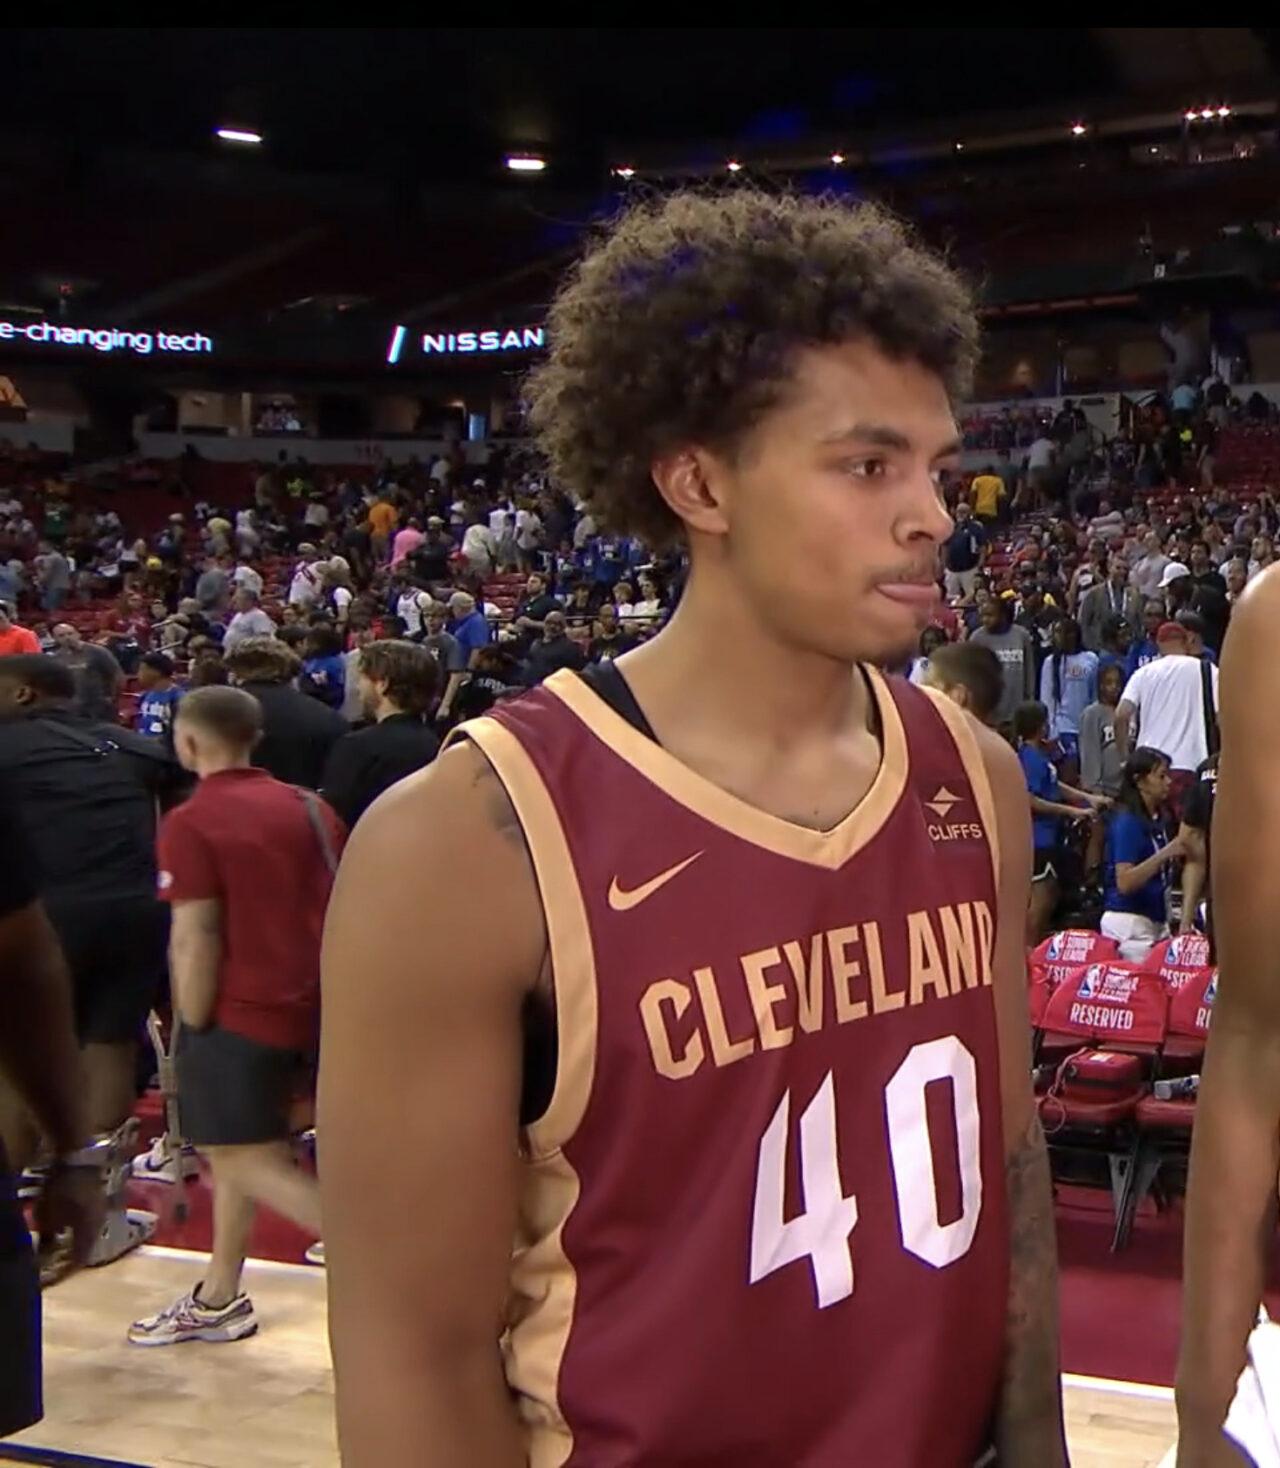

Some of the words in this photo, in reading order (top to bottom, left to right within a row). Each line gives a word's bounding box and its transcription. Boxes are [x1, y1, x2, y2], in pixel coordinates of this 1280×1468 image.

[157, 332, 212, 352] tech
[423, 328, 544, 352] NISSAN
[928, 823, 983, 841] CLIFFS
[638, 900, 993, 1080] CLEVELAND
[1070, 1002, 1134, 1030] RESERVED
[750, 1035, 982, 1310] 40
